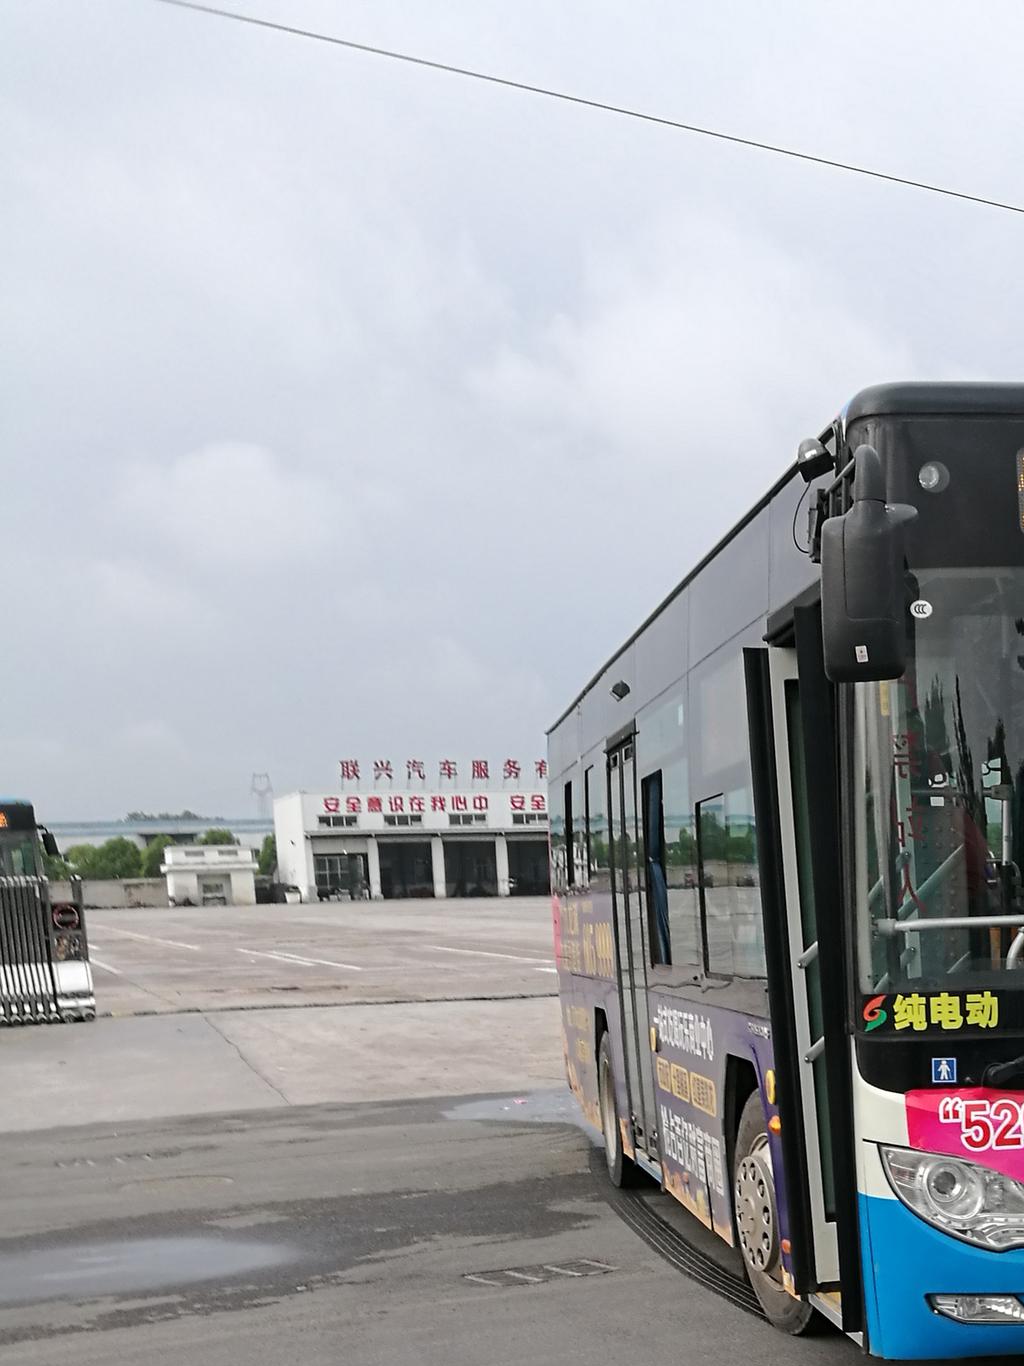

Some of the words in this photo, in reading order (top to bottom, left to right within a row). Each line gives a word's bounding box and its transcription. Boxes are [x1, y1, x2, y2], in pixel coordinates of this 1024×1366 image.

[324, 796, 489, 812] 安全意识在我心中
[892, 991, 999, 1031] 纯电动
